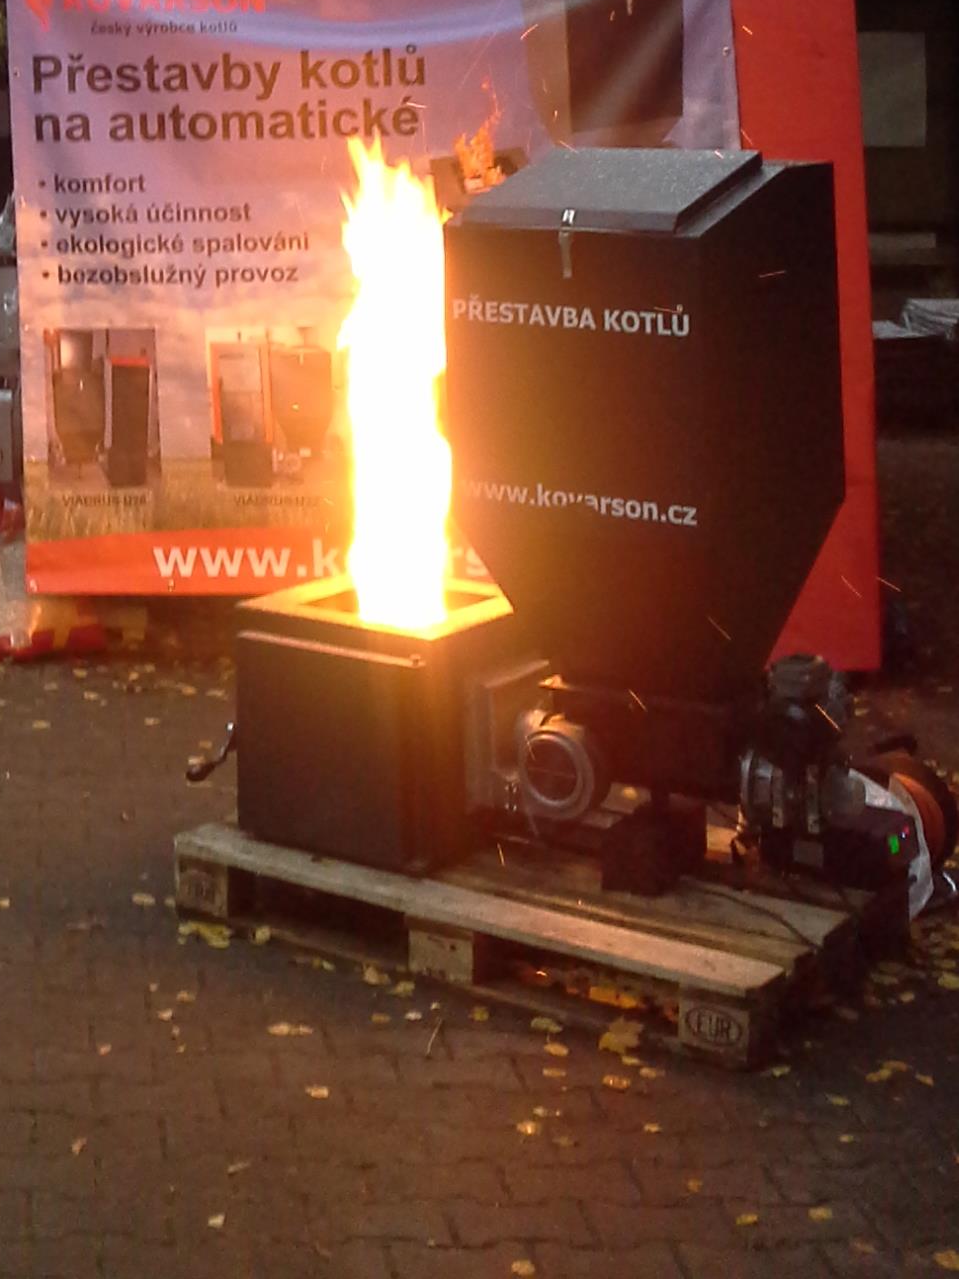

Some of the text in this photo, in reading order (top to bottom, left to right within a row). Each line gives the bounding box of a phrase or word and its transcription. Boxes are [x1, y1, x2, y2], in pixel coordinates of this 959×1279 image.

[91, 19, 237, 37] český výrobce kotlů
[32, 45, 426, 99] Přestavby kotlů
[34, 97, 420, 142] na automatické
[54, 173, 145, 193] komfort
[56, 200, 251, 227] vysoká účinnost
[56, 232, 183, 257] ekologické
[57, 263, 299, 288] bezobslužný provoz
[452, 293, 690, 337] PŘESTAVBA KOTLŮ
